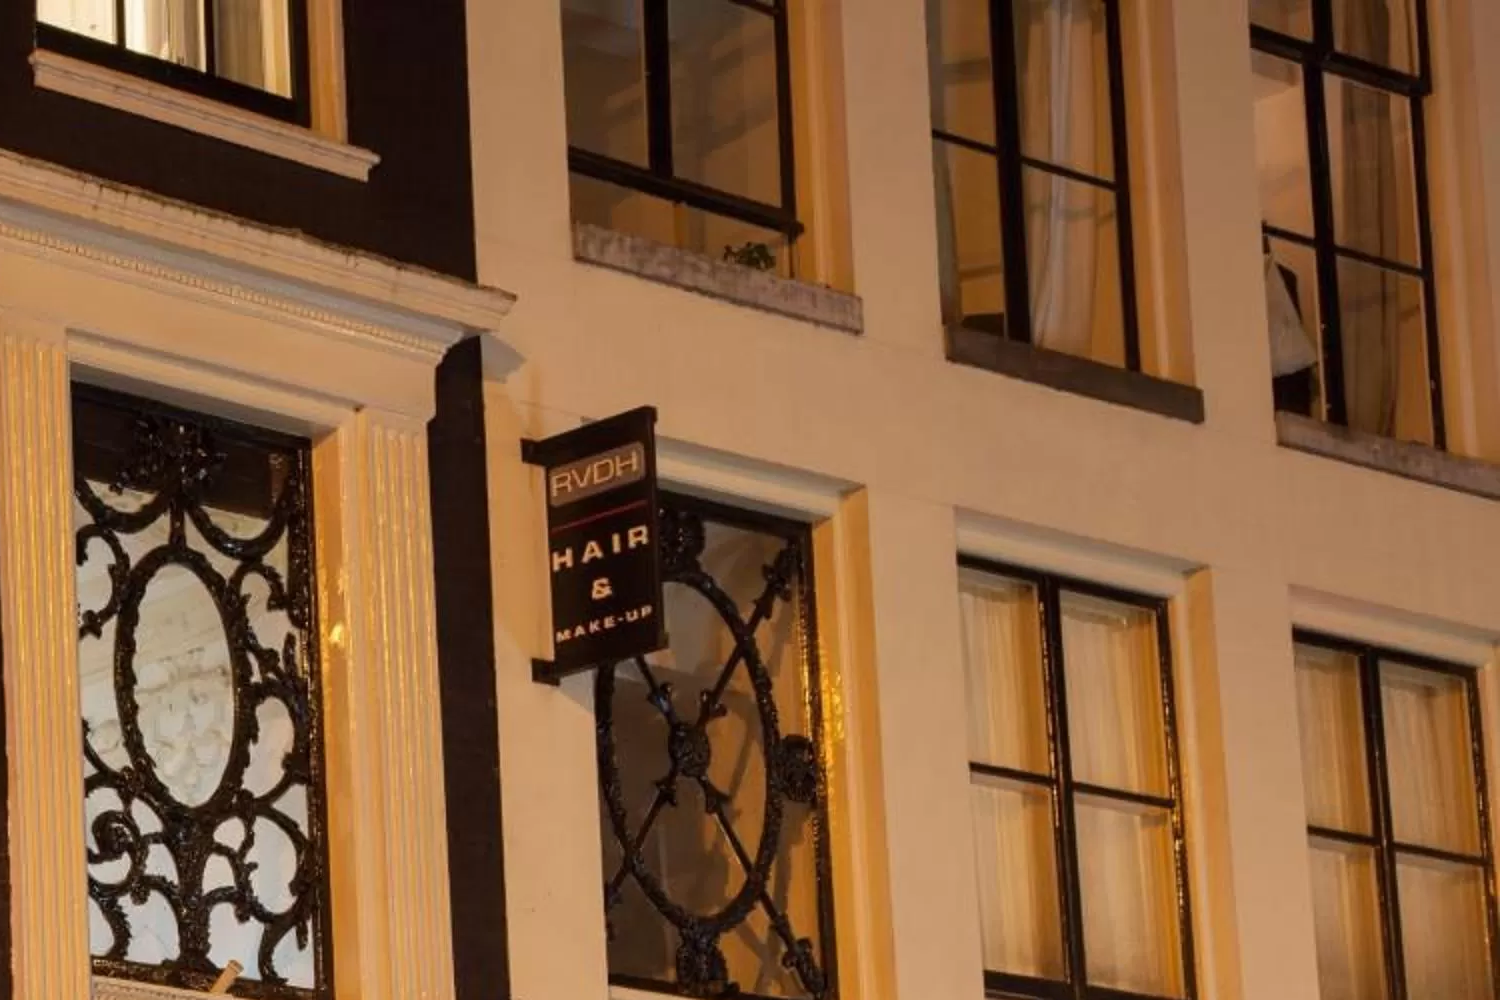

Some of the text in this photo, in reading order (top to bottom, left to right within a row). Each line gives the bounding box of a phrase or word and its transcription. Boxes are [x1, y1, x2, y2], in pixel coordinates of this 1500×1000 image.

[552, 451, 640, 497] RVDH
[552, 524, 650, 572] HAIR
[591, 577, 613, 600] &
[556, 604, 653, 644] MAKE-UP
